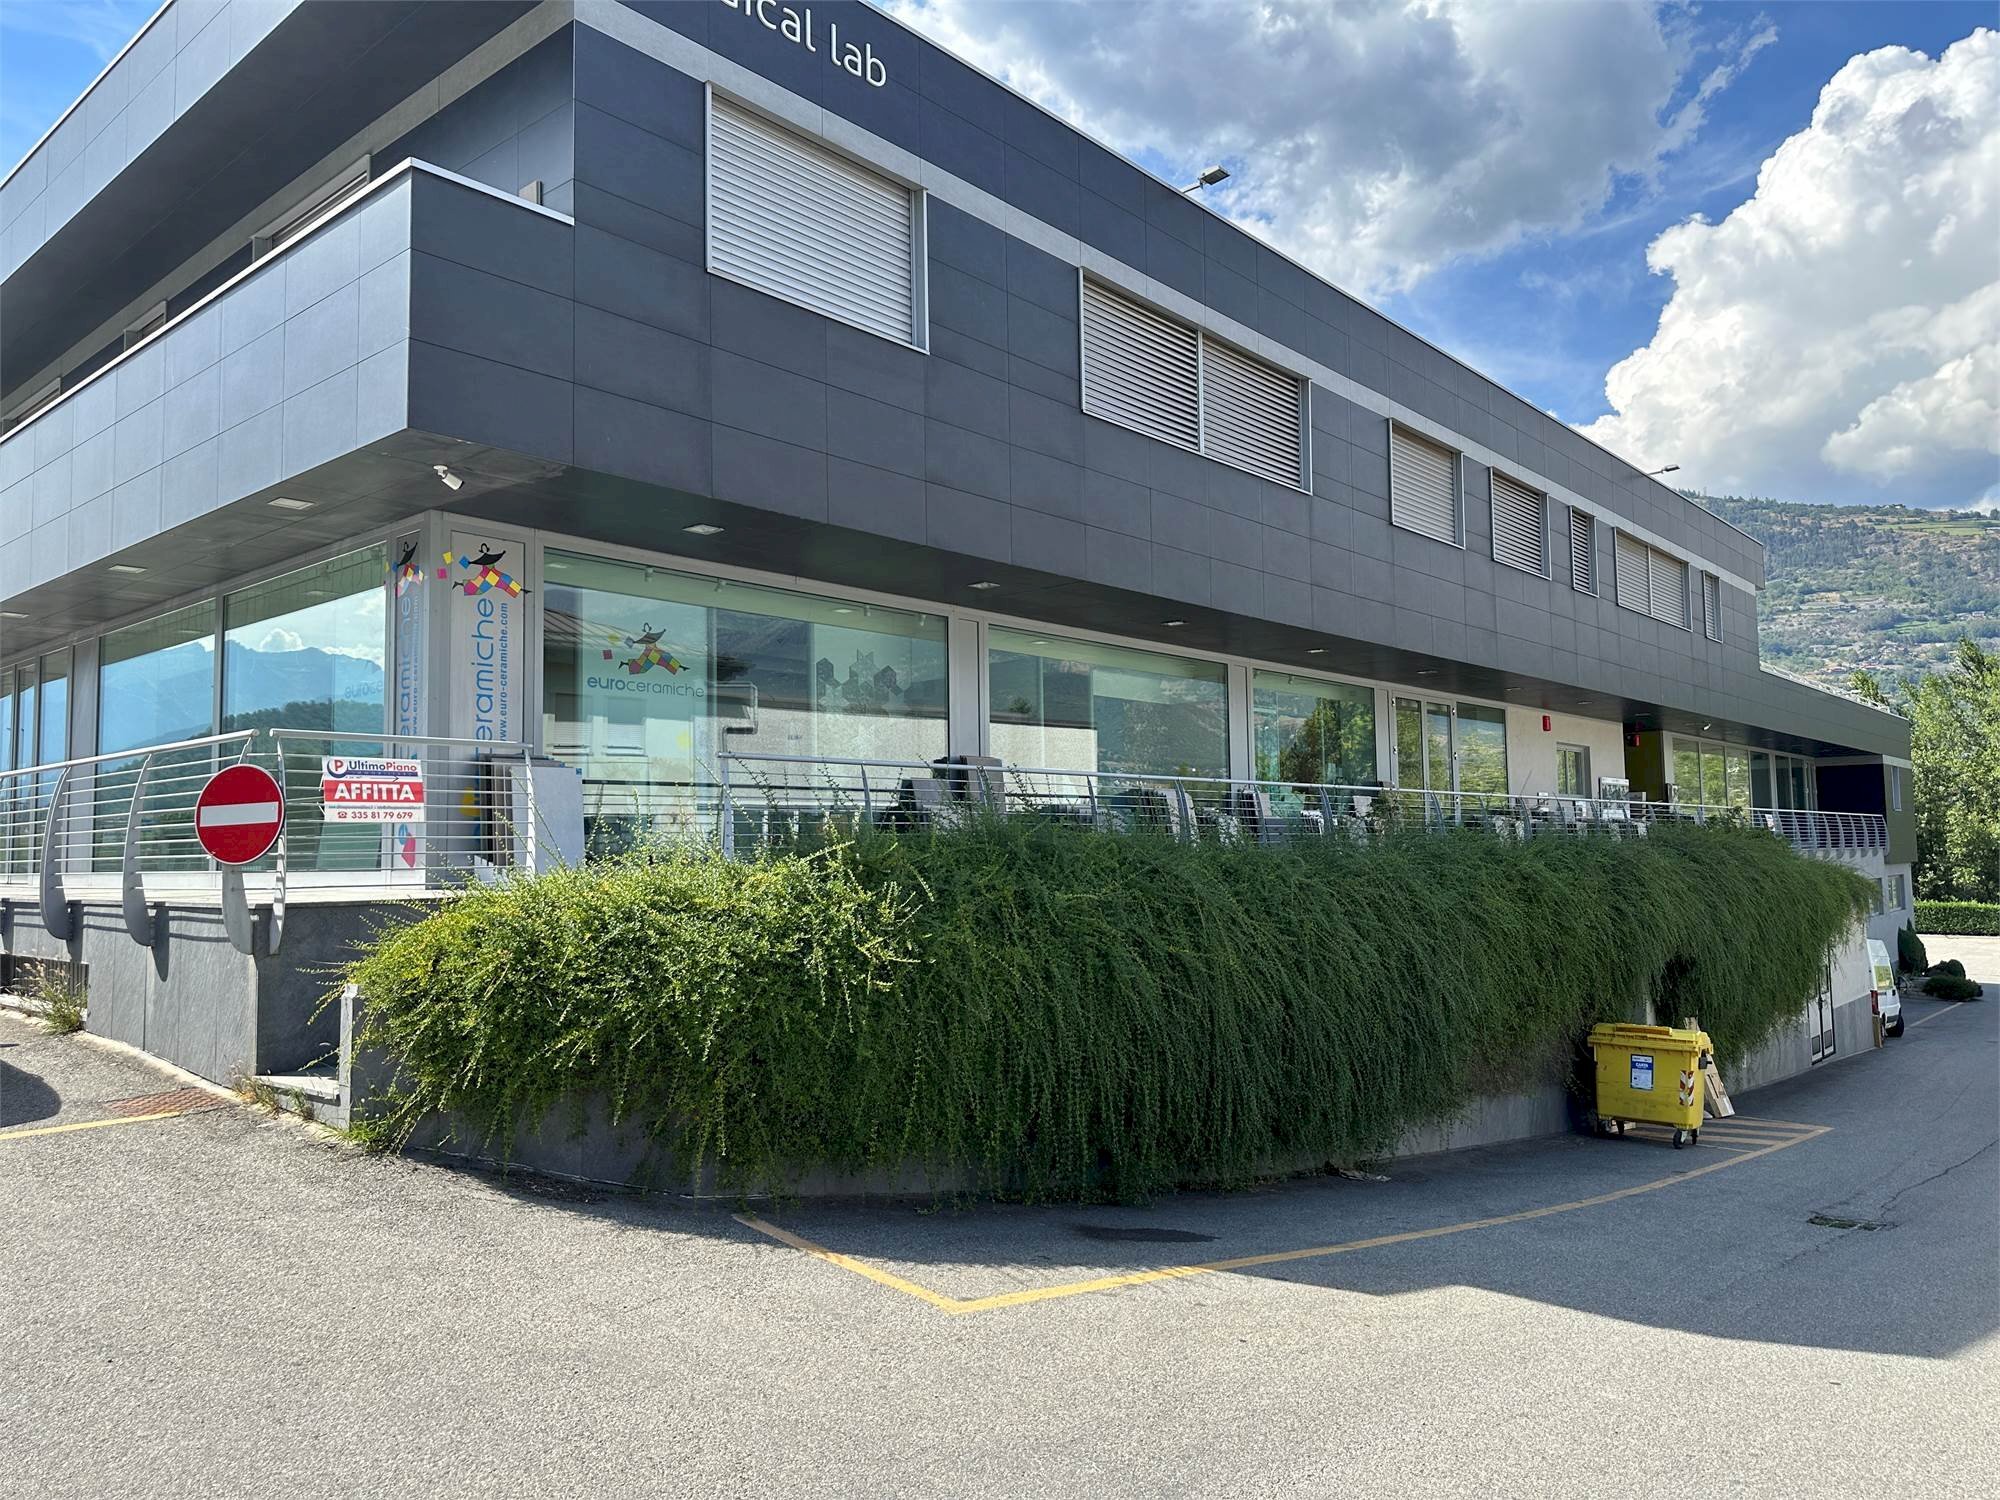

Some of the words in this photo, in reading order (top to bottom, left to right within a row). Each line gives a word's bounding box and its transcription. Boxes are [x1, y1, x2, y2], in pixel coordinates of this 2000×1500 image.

[830, 23, 887, 87] lab
[500, 602, 508, 741] ww.euro-ceramiche.com
[587, 677, 704, 697] euroceramiche
[349, 760, 417, 771] UltimoPiano
[334, 783, 415, 800] AFFITTA
[351, 811, 368, 819] 335
[370, 811, 380, 819] 81
[383, 811, 394, 819] 79
[396, 811, 413, 819] 679
